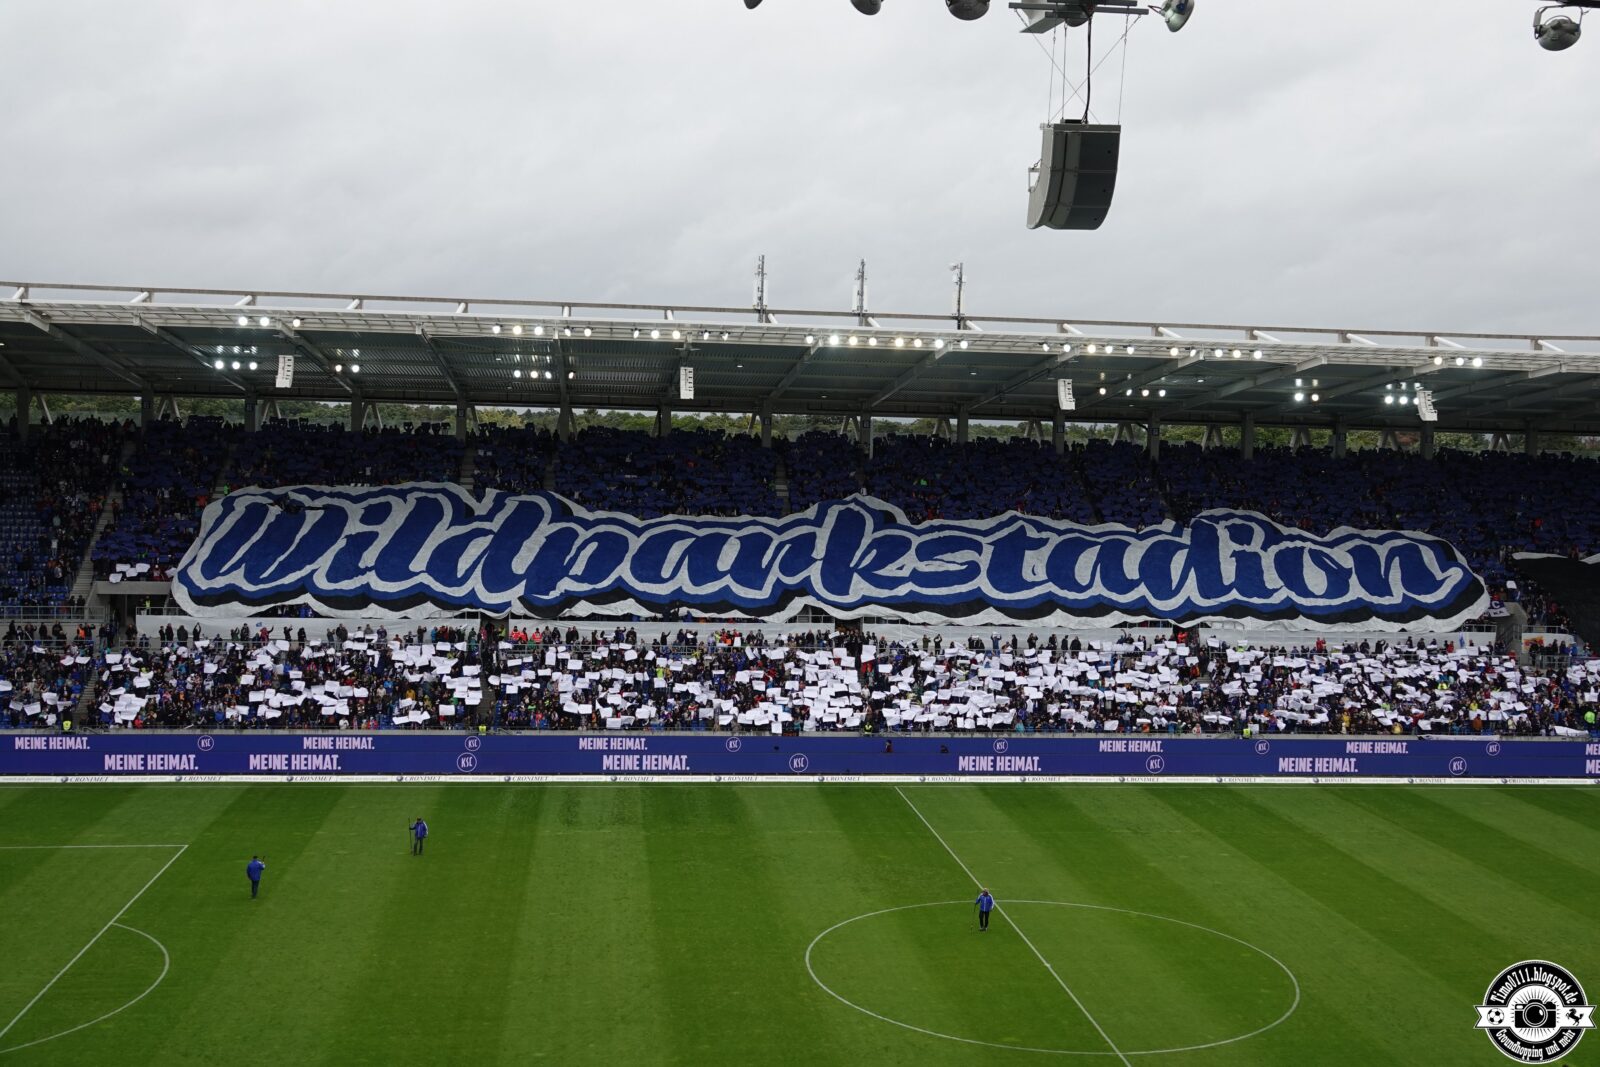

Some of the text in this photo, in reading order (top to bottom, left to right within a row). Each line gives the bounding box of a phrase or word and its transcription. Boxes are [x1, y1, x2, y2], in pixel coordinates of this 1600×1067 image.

[182, 486, 1478, 612] Wildparkstadion
[14, 736, 91, 750] MEINE HEIMAT.
[303, 736, 375, 750] MEINE HEIMAT.
[579, 737, 648, 751] MEINE HEIMAT.
[1099, 740, 1164, 753] MEINE HEIMAT.
[1346, 742, 1409, 754] MEINE HEIMAT.
[104, 754, 199, 770] MEINE HEIMAT.
[250, 754, 342, 770] MEINE HEIMAT.
[602, 755, 690, 771] MEINE HEIMAT.
[958, 755, 1042, 772] MEINE HEIMAT.
[1278, 757, 1359, 773] MEINE HEIMAT.
